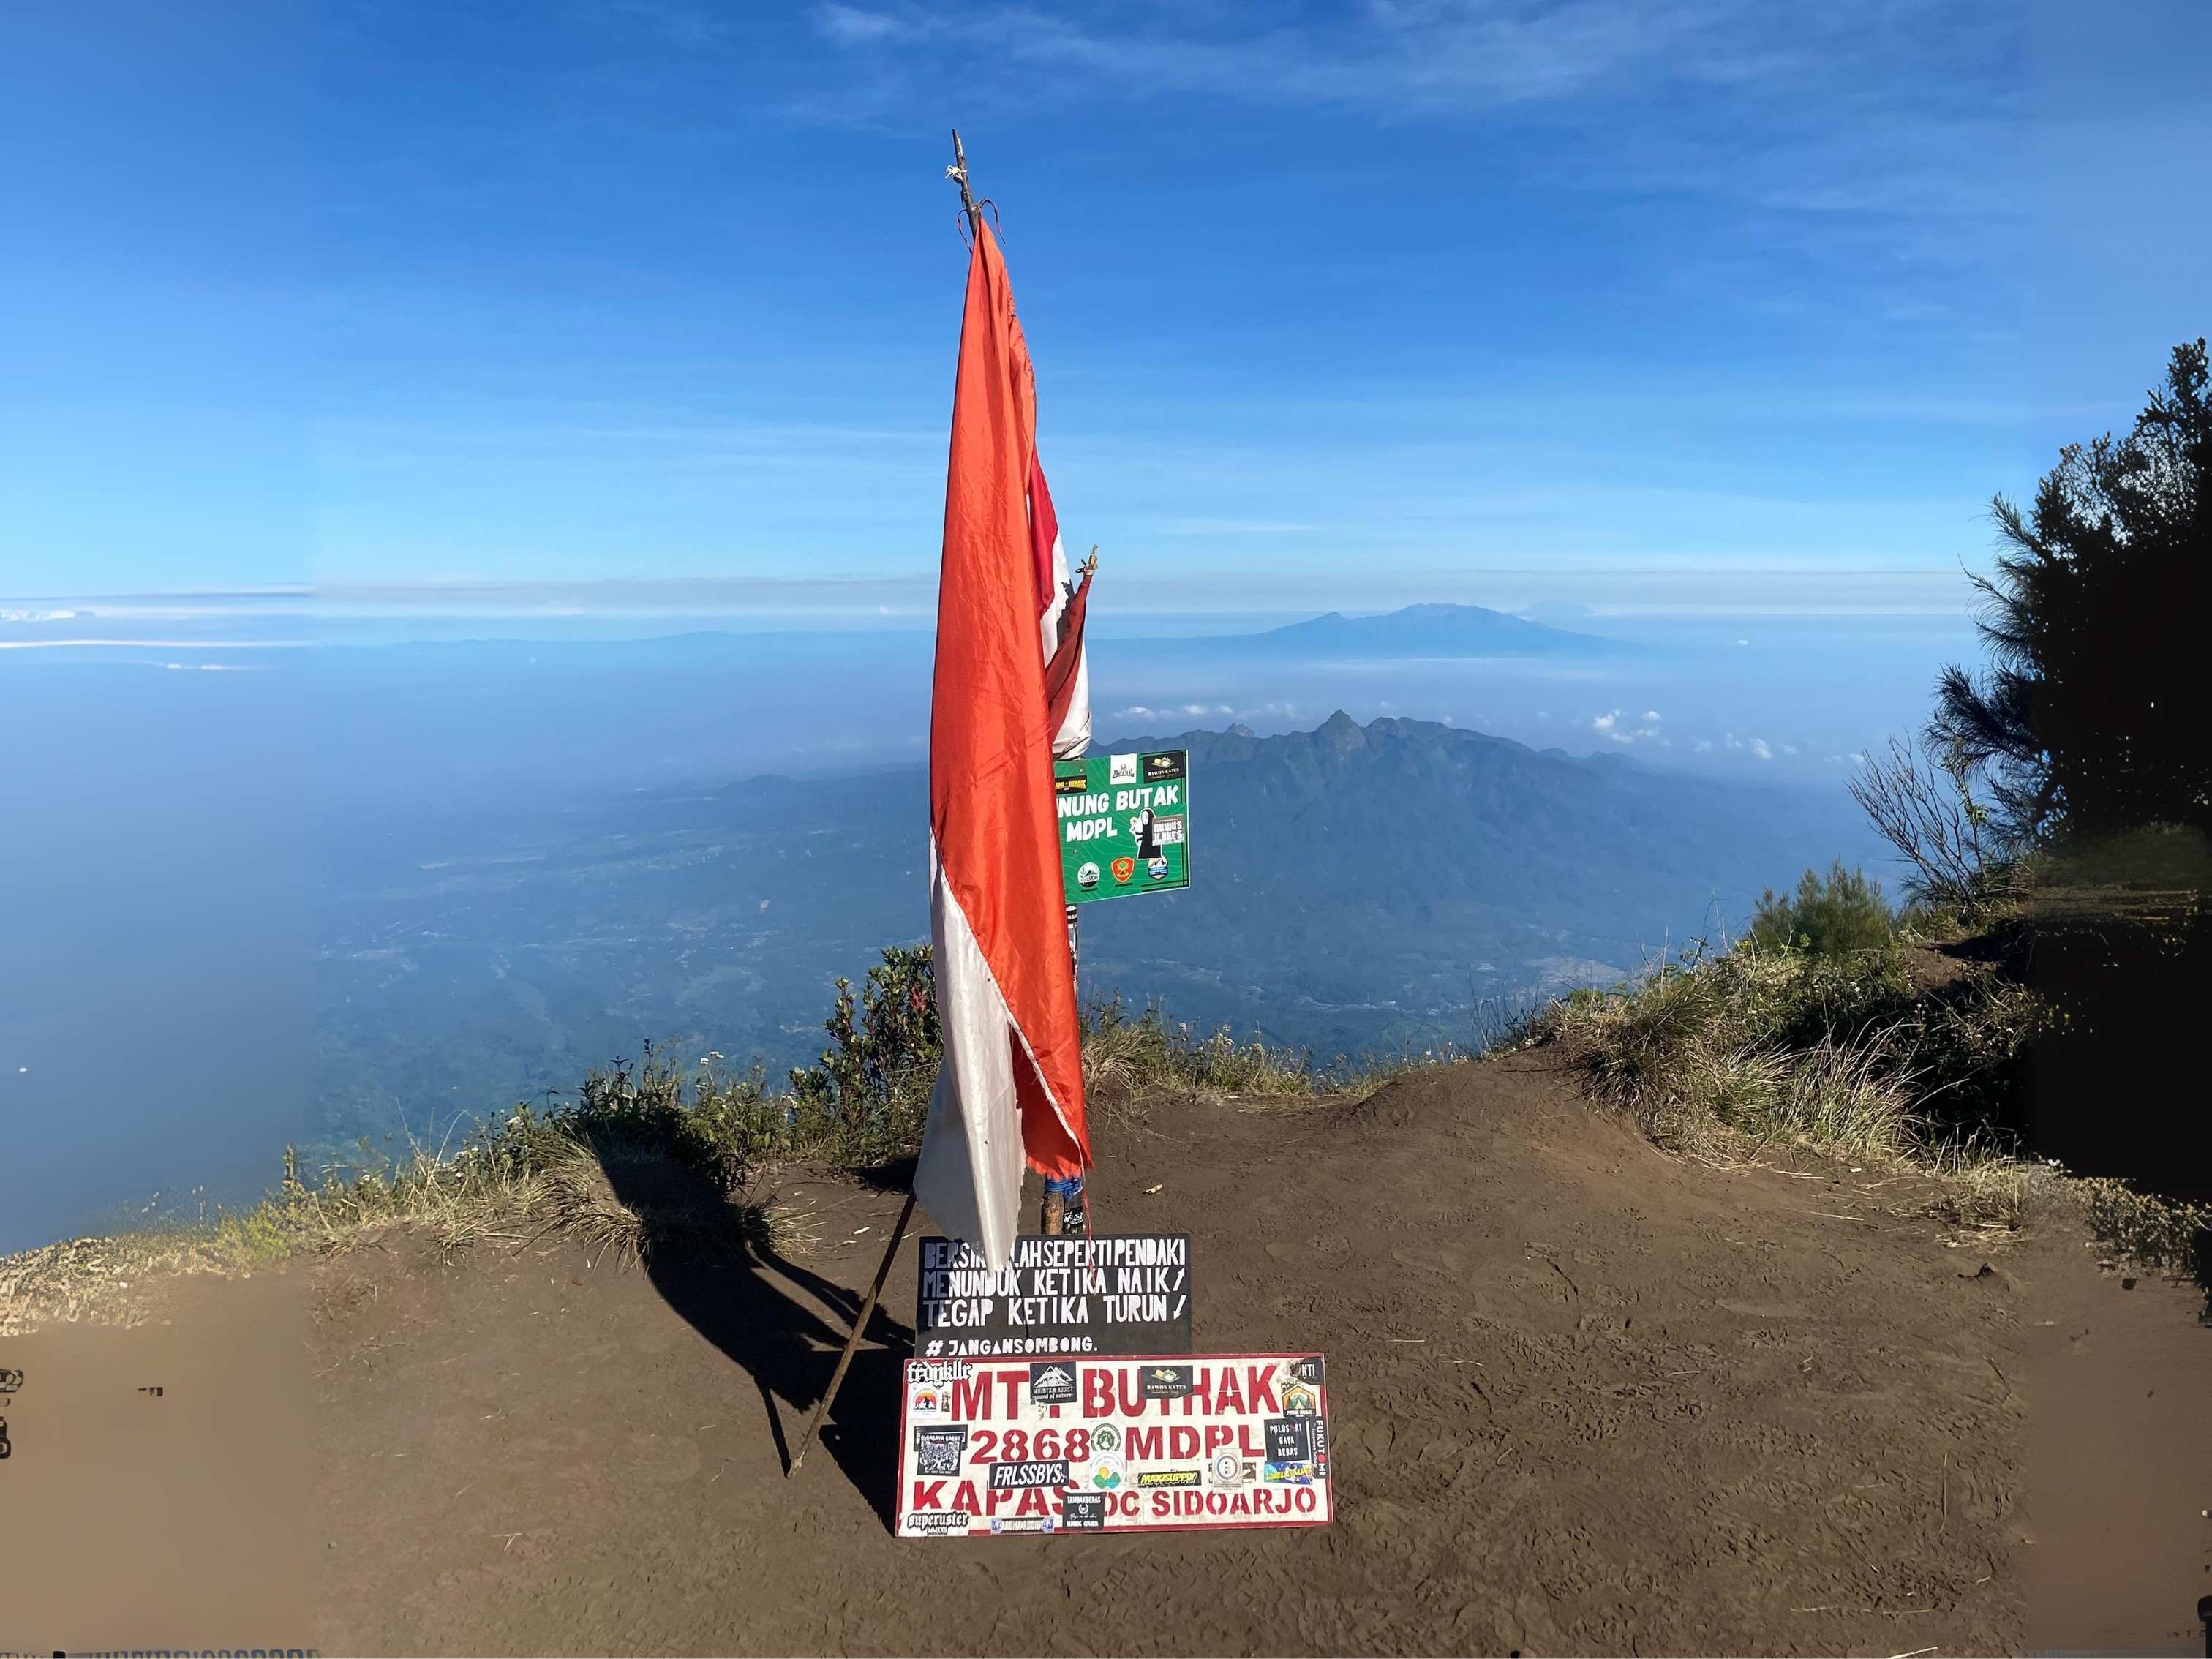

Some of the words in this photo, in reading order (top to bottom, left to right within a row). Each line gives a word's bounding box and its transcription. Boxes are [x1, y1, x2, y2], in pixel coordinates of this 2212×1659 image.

[1116, 785, 1178, 811] BUTAK
[1066, 817, 1118, 842] MDPL
[922, 1269, 1022, 1298] MENUNDUK
[1034, 1268, 1107, 1295] KETIKA
[1118, 1267, 1170, 1293] NAIK
[923, 1298, 993, 1327] TEGAP
[1008, 1296, 1089, 1325] KETIKA
[1103, 1294, 1167, 1323] TURUN
[969, 1429, 1090, 1464] 2868
[1125, 1424, 1265, 1461] MDPL
[1277, 1448, 1298, 1456] BEBAS
[1279, 1436, 1295, 1445] GAYA
[1151, 1487, 1317, 1517] SIDOARJO
